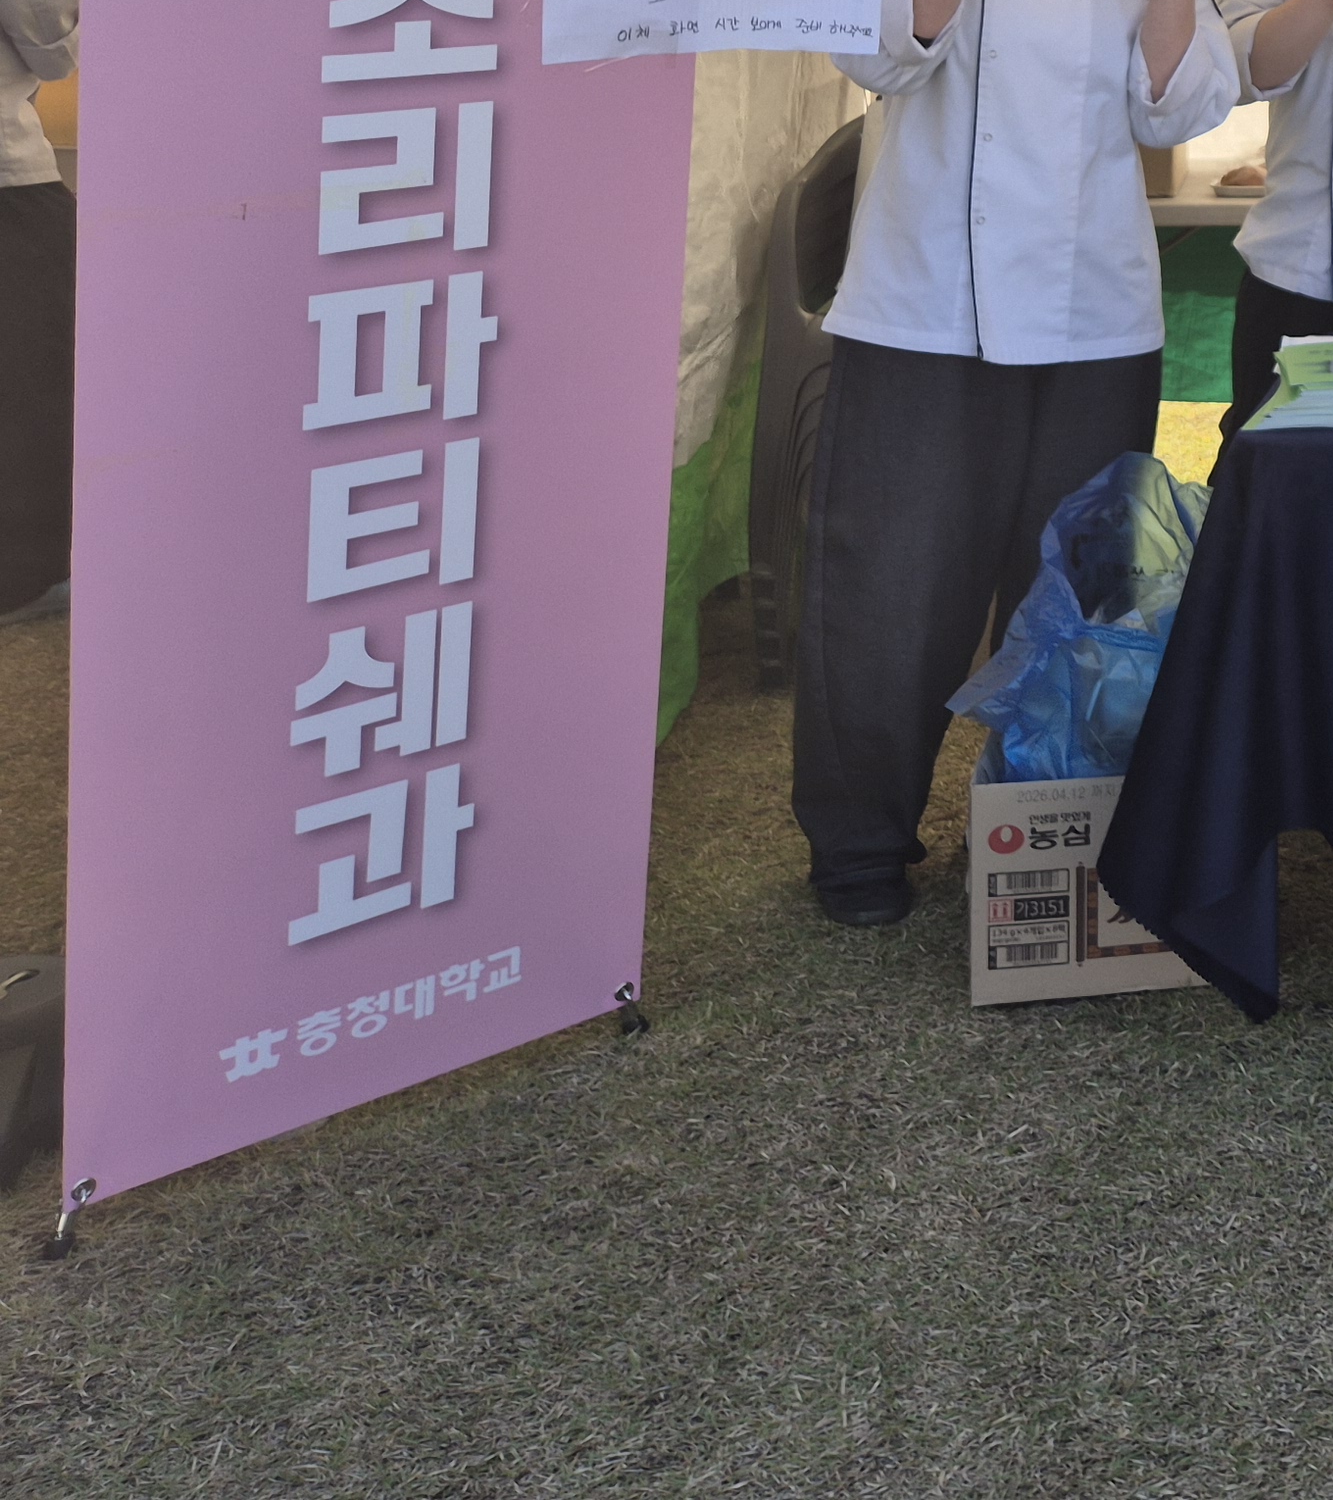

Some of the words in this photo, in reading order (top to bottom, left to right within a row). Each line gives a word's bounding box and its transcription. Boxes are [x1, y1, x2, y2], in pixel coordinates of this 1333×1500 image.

[617, 24, 650, 43] 이체
[669, 19, 700, 37] 화면
[715, 16, 740, 32] 시간
[1017, 786, 1086, 803] 2026.04.12
[1028, 812, 1059, 825] 인생을
[1060, 811, 1092, 822] 맛있게
[1028, 823, 1091, 850] 농심
[295, 945, 523, 1058] 충청대학교
